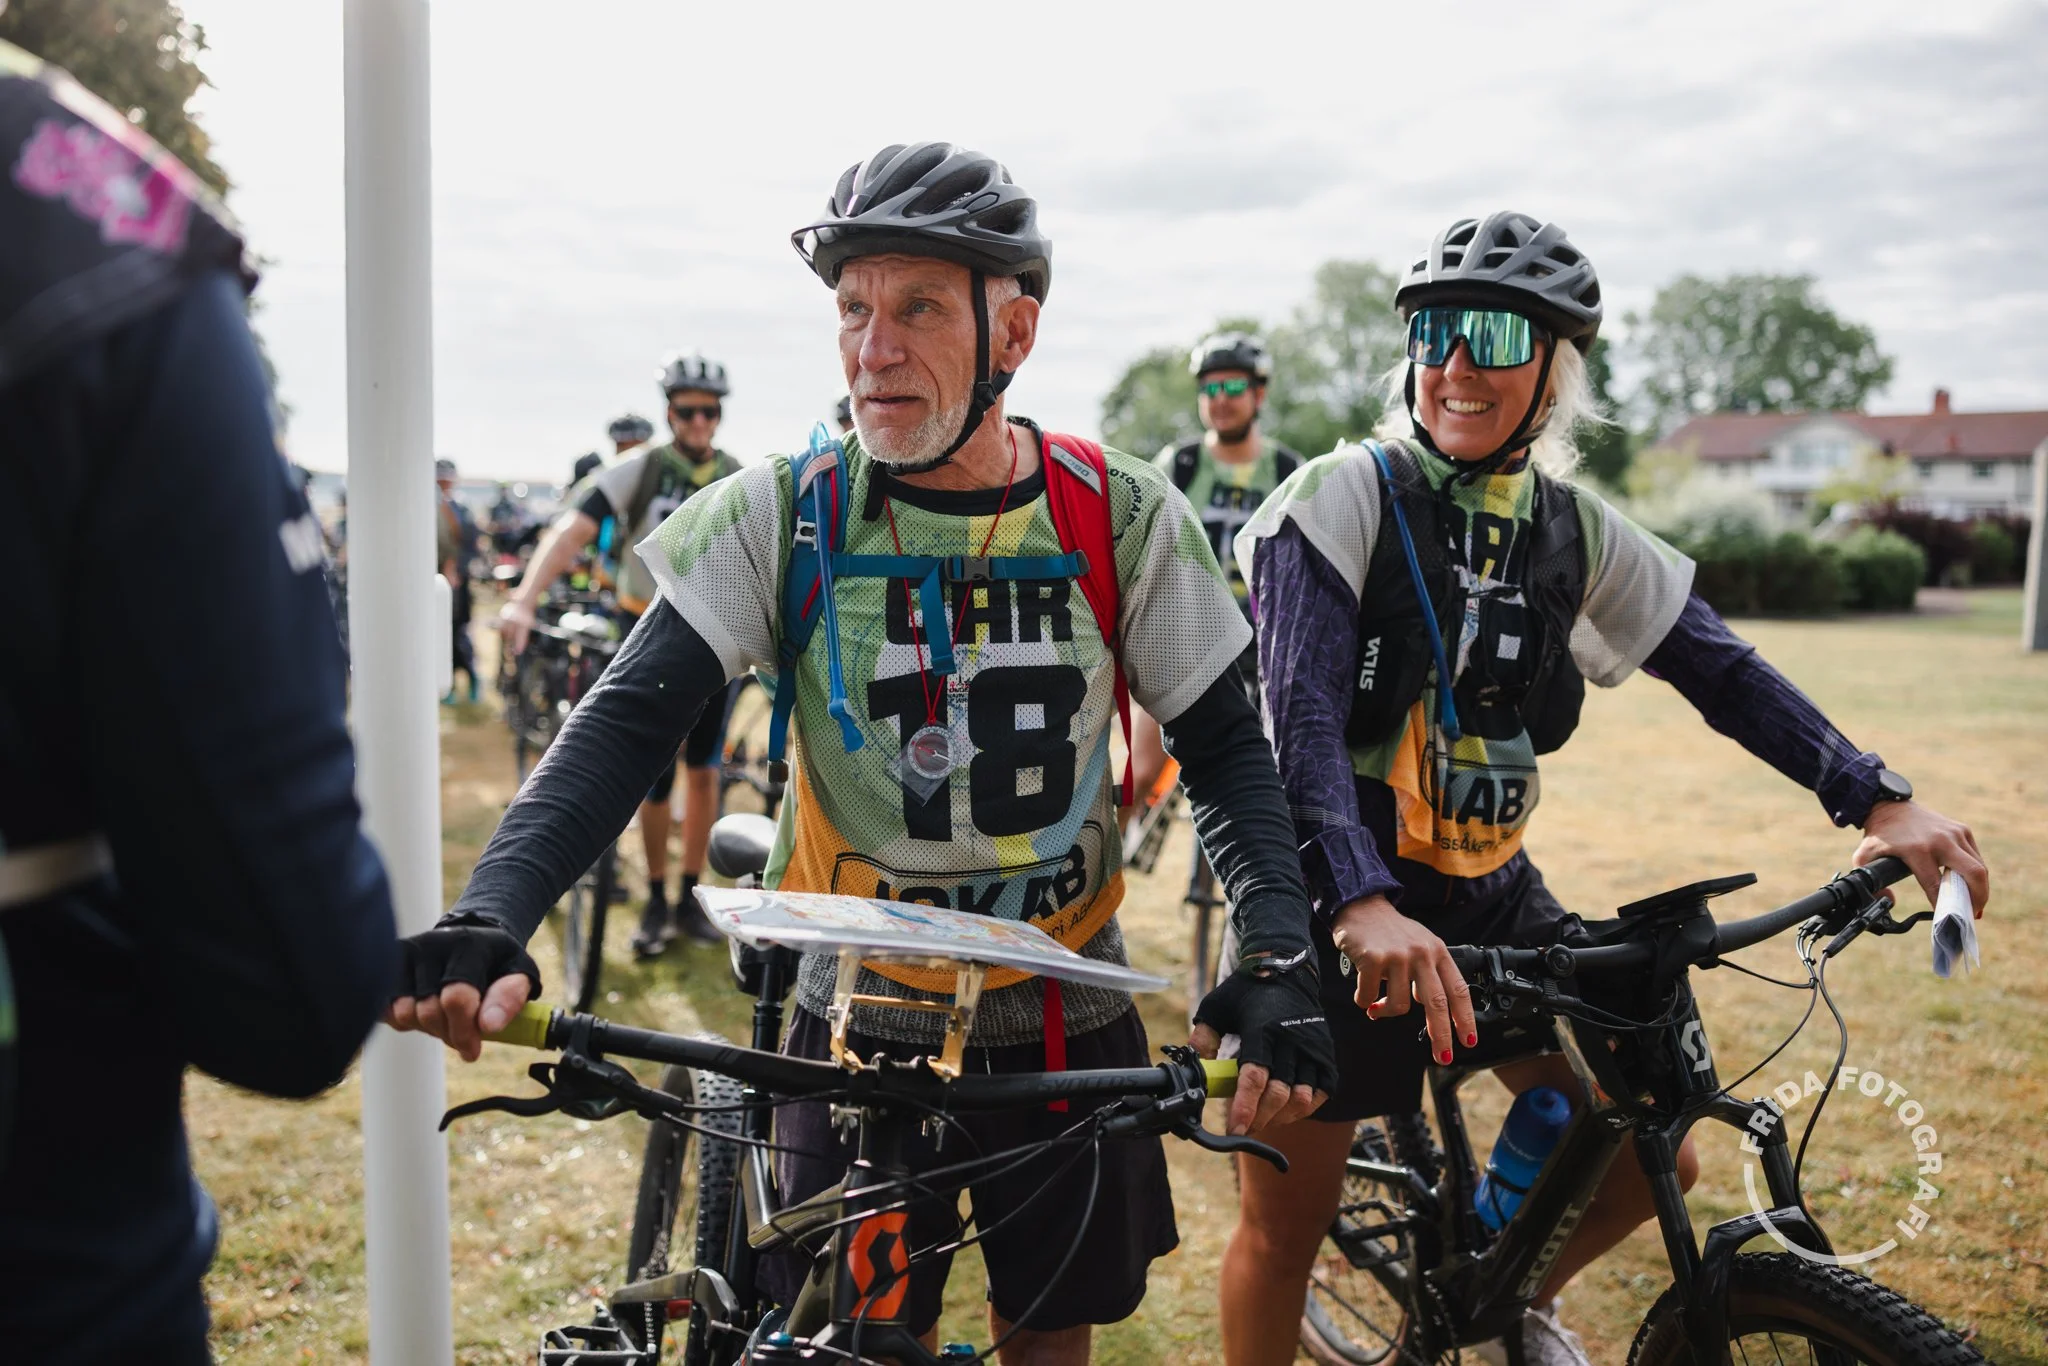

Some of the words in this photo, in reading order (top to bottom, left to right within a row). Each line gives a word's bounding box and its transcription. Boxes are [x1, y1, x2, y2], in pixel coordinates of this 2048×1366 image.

[1359, 636, 1381, 690] SILVA
[866, 664, 1088, 842] 18
[1516, 1203, 1582, 1297] SCOTT
